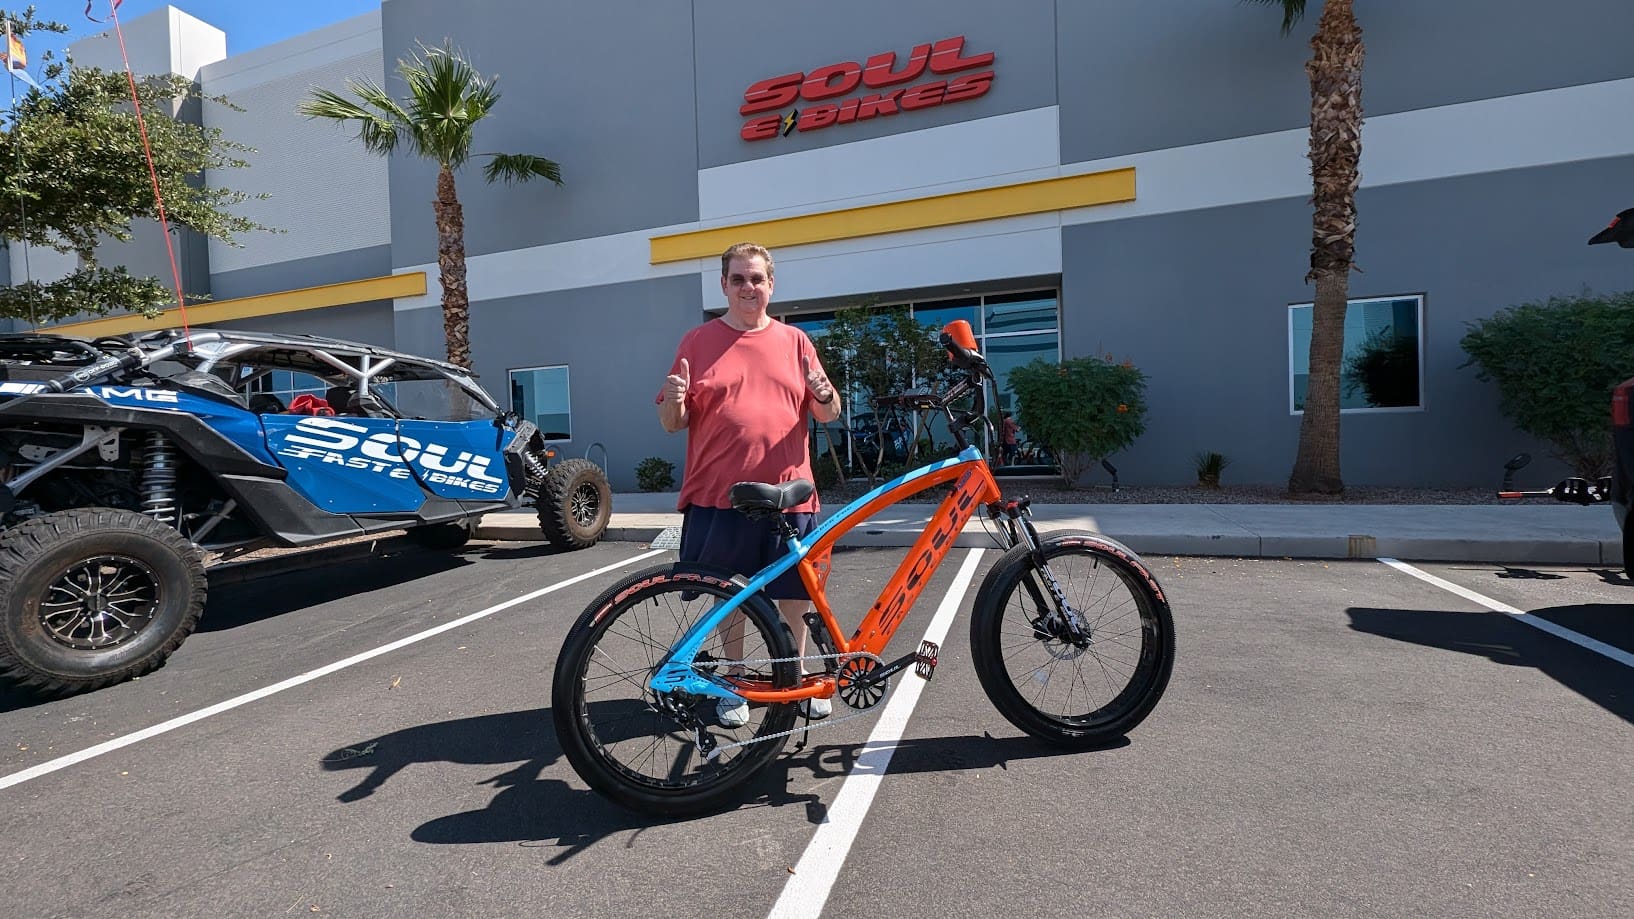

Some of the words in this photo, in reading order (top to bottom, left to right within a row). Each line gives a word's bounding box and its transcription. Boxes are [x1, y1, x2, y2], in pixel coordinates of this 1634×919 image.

[739, 35, 995, 116] SOUL
[284, 417, 503, 484] SOUL
[614, 575, 673, 604] SOUL
[673, 573, 733, 589] FAST
[877, 479, 985, 637] SOUL
